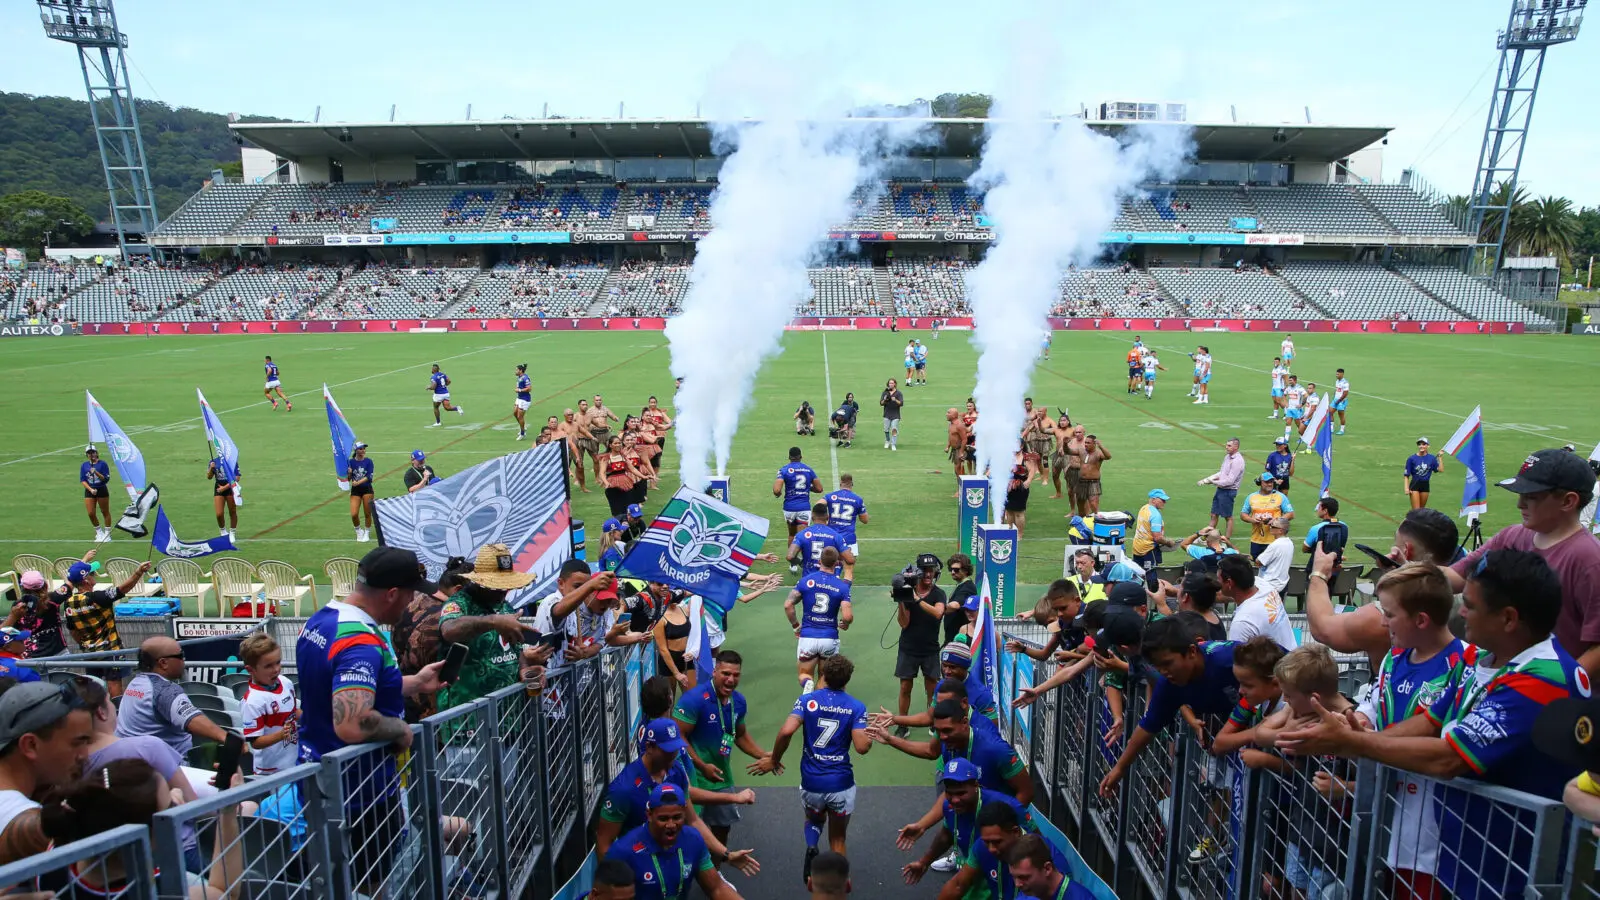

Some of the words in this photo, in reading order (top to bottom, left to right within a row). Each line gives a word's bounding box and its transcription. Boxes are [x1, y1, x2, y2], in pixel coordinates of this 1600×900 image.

[648, 232, 686, 241] canterbury
[898, 232, 936, 241] canterbury
[2, 326, 50, 335] AUTEX
[795, 474, 807, 490] 2
[831, 503, 855, 521] 12
[811, 541, 825, 560] 5
[658, 551, 711, 584] WARRIORS
[816, 582, 840, 593] vodafone
[811, 592, 830, 614] 3
[820, 705, 853, 715] vodafone
[813, 717, 840, 749] 7
